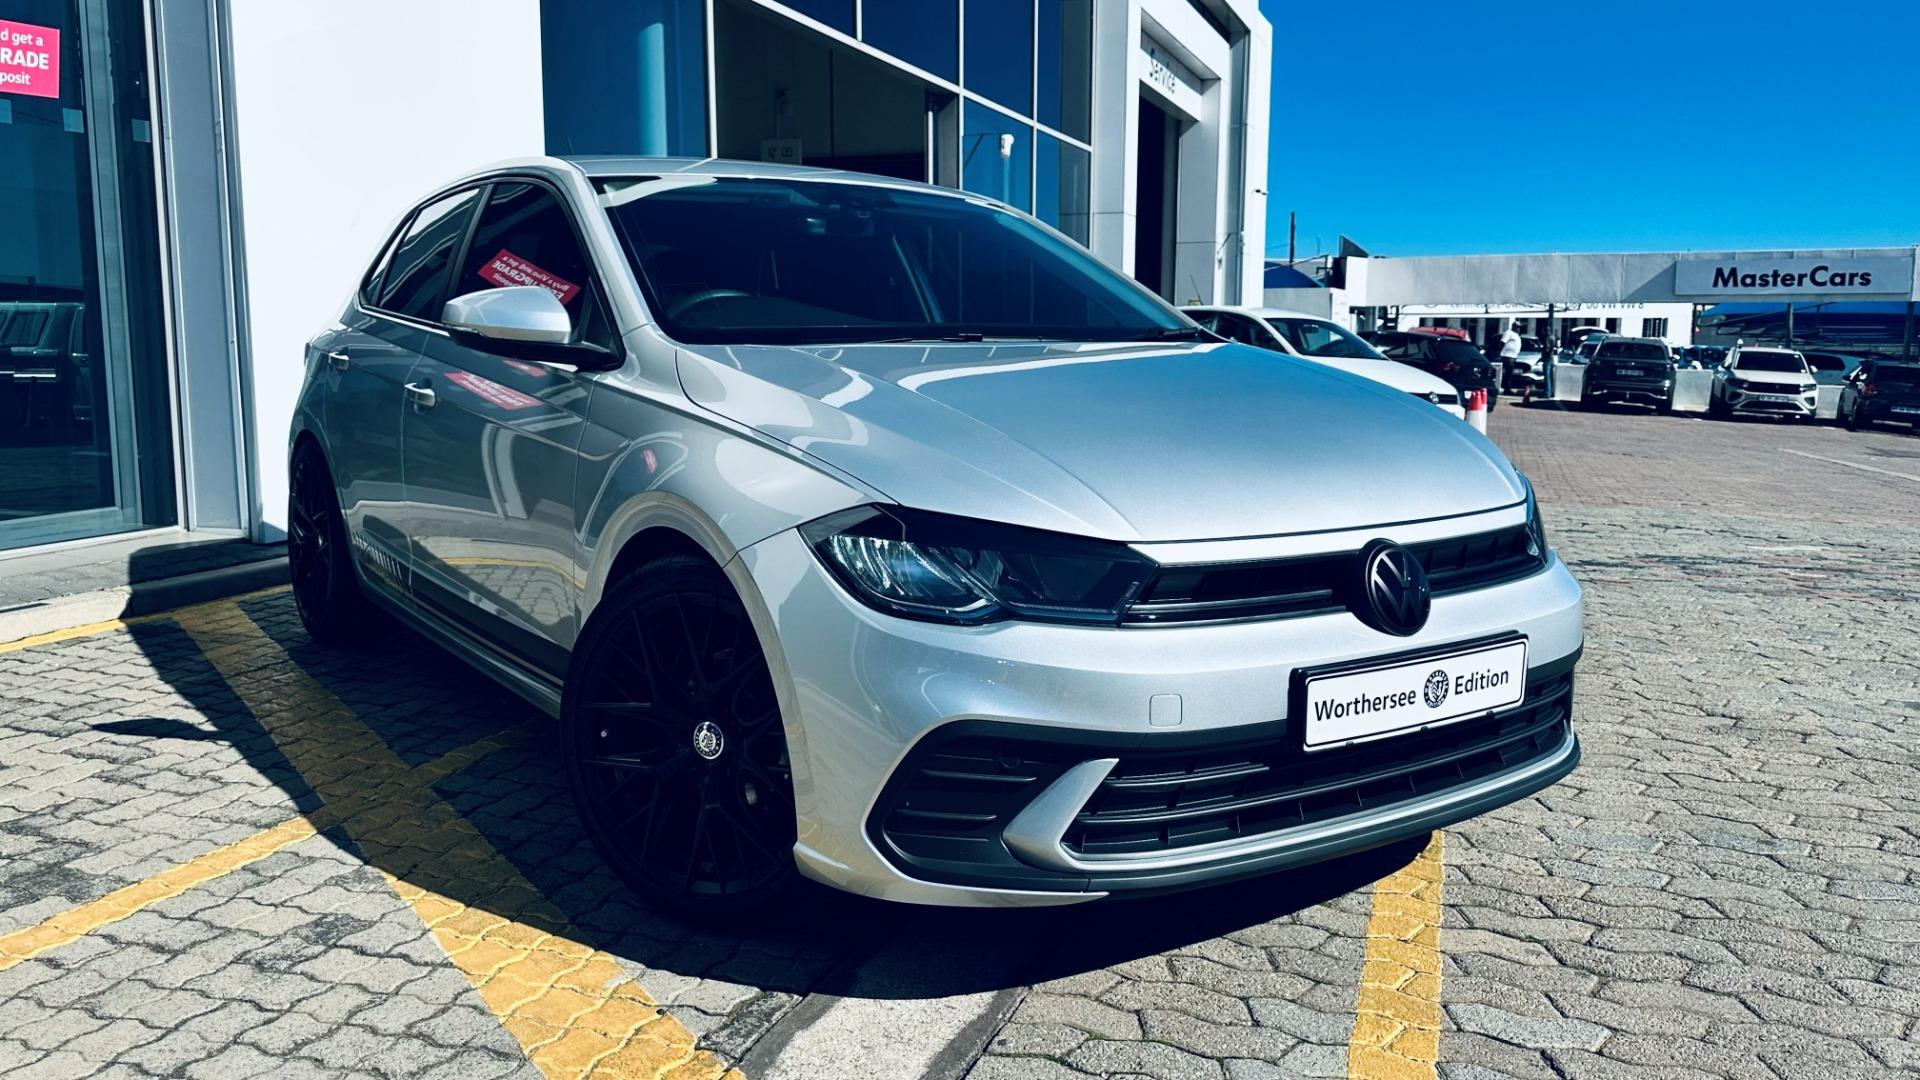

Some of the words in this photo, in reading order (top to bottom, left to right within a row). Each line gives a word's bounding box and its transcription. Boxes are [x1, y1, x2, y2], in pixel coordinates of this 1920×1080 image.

[12, 33, 33, 46] get
[35, 36, 44, 46] a
[1150, 47, 1175, 94] Service
[1712, 265, 1872, 288] MasterCars
[1314, 689, 1417, 722] Worthersee
[1454, 668, 1509, 696] Edition
